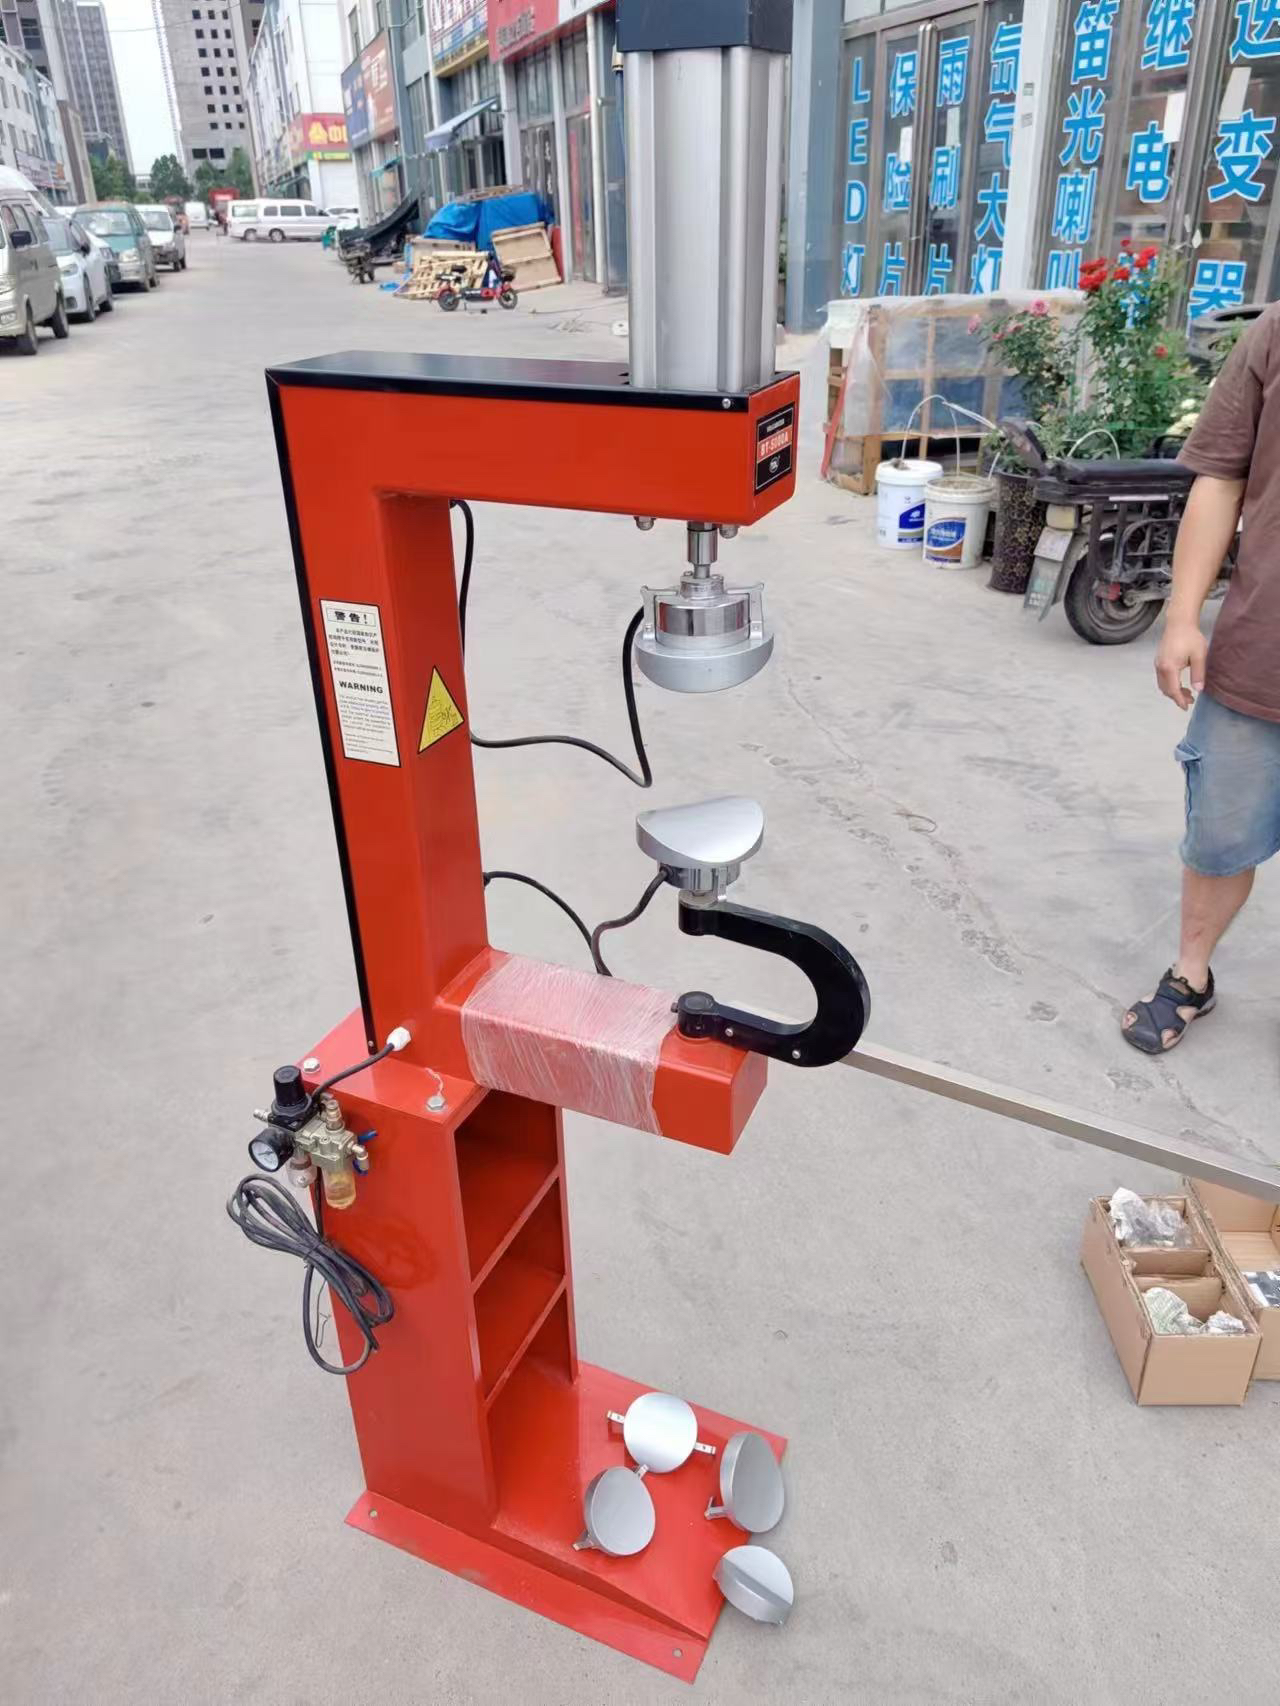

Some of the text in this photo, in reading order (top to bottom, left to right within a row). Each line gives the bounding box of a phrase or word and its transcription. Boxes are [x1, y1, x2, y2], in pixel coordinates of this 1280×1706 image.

[879, 51, 918, 296] 保险片
[923, 36, 971, 296] 雨刷片
[338, 680, 384, 694] WARNING
